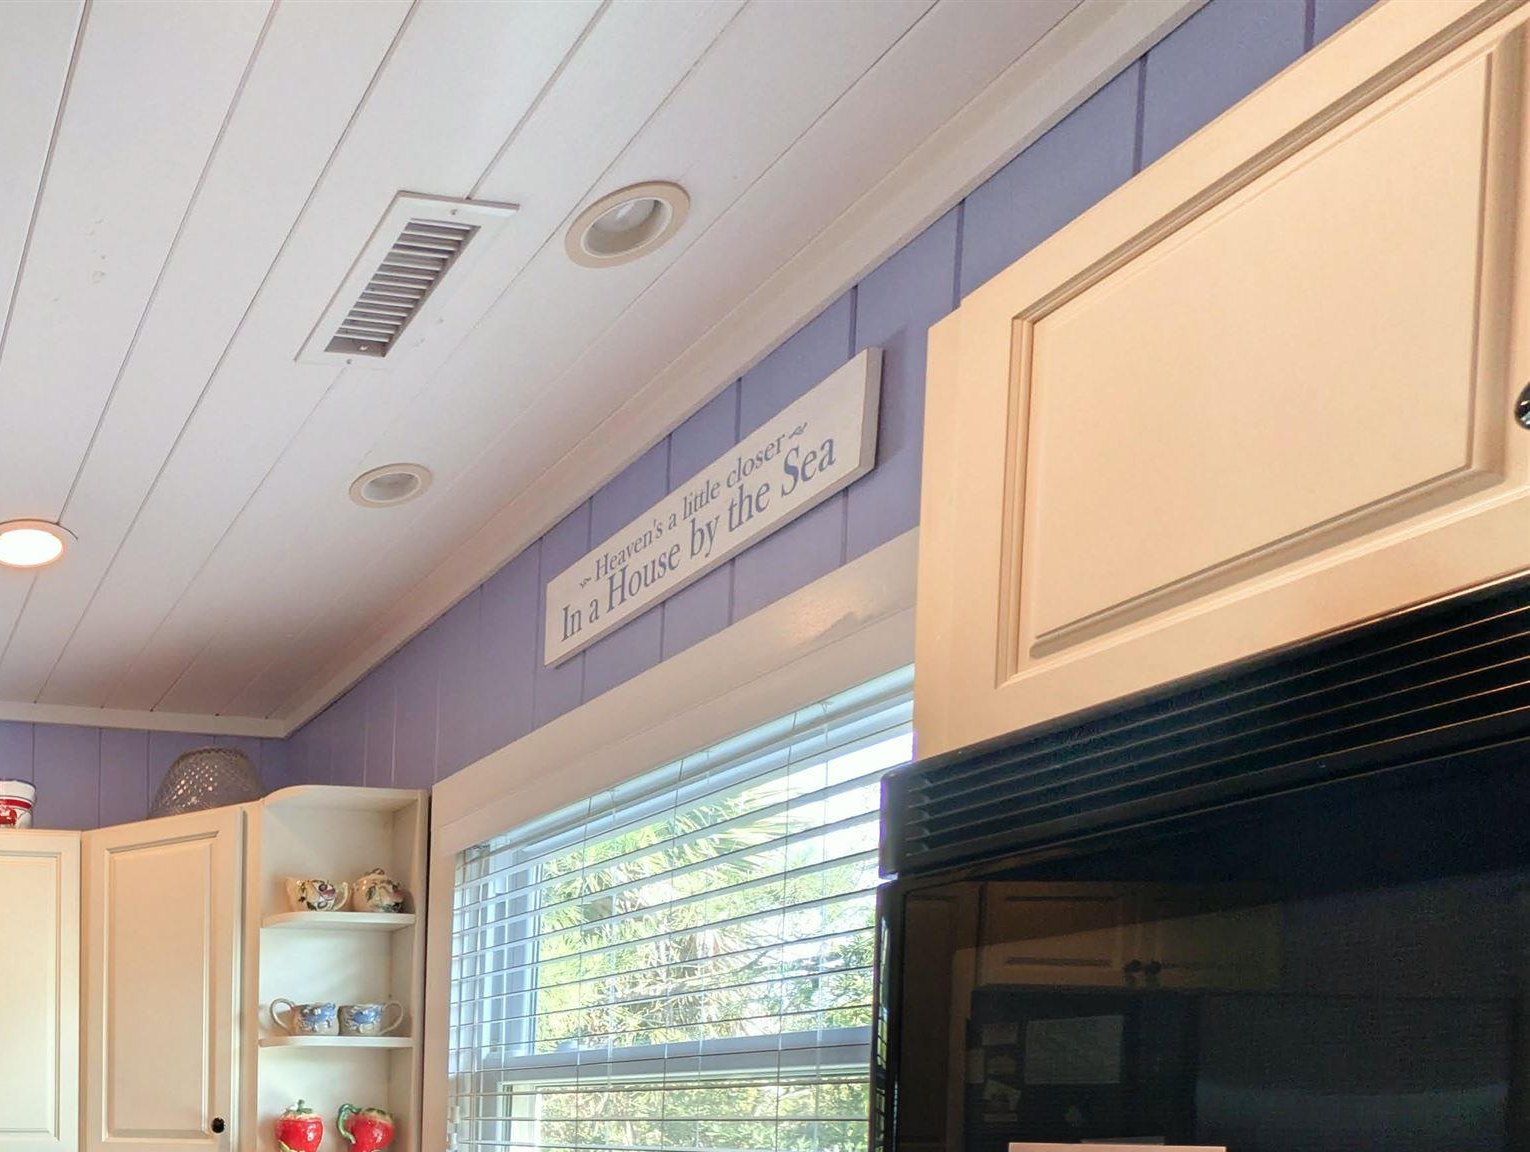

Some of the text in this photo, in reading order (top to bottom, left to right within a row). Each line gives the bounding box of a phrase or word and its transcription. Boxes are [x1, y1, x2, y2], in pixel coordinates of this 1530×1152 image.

[561, 437, 836, 642] In a House by the Sea
[595, 433, 786, 581] Heaven's a little closer
